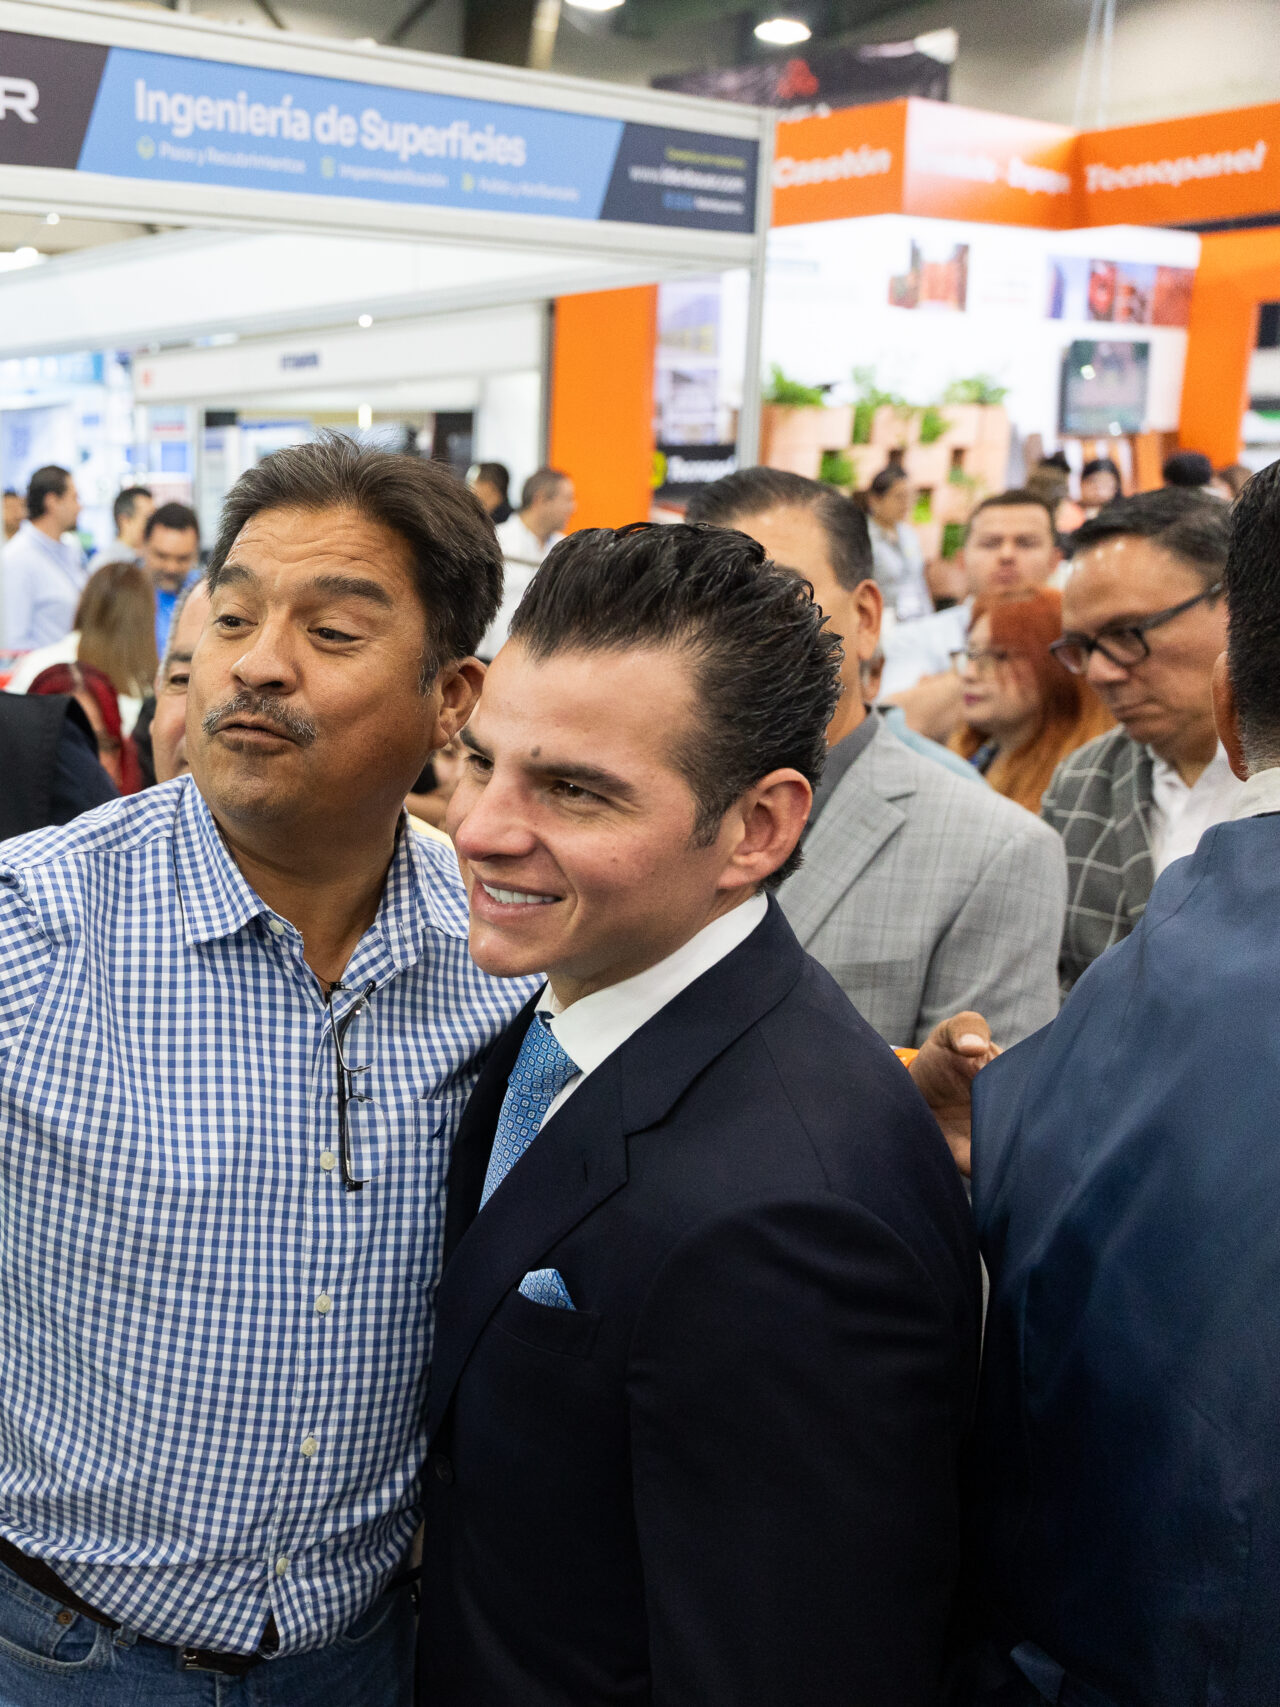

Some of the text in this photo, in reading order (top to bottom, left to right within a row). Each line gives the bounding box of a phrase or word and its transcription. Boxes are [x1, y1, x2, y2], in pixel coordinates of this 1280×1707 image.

[135, 78, 527, 168] Ingeniería de Superficies
